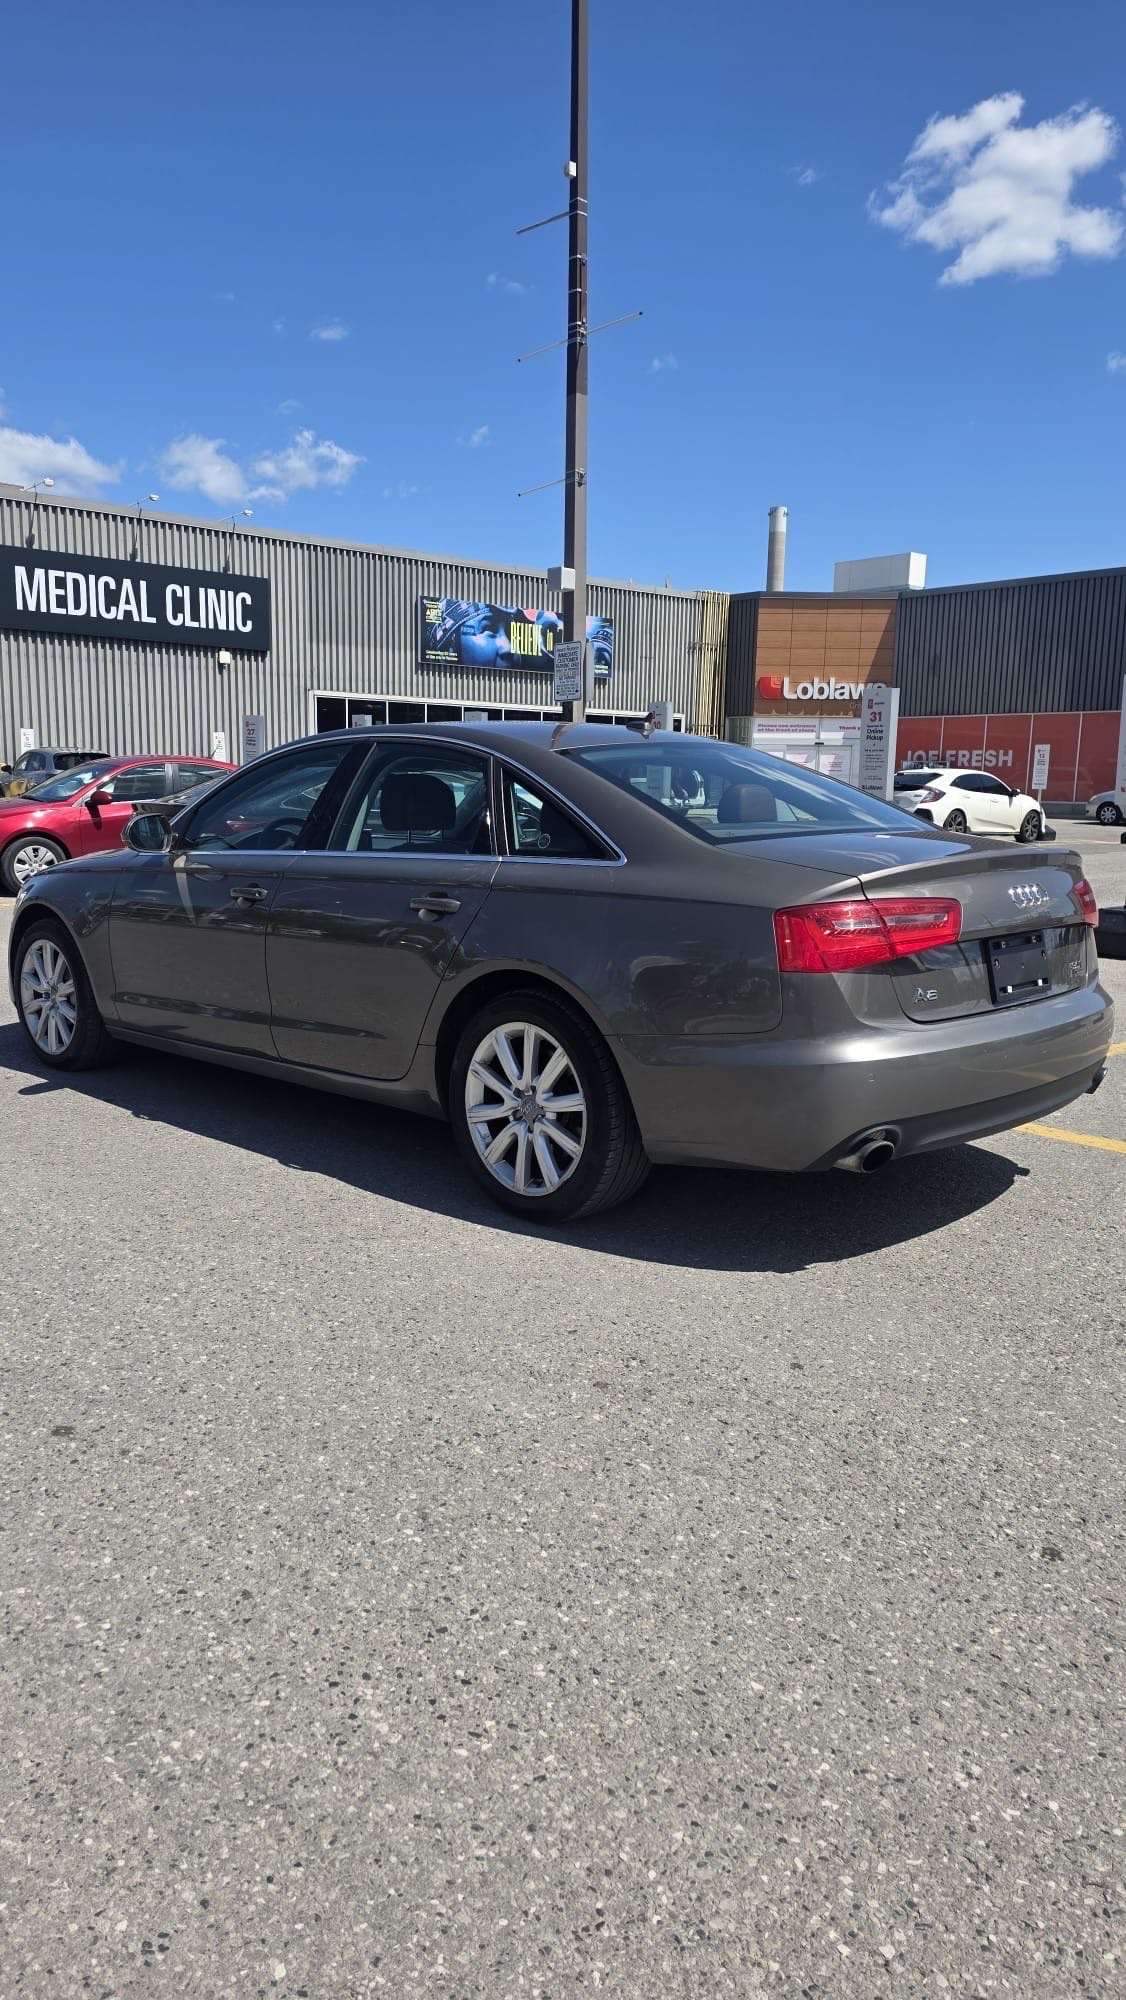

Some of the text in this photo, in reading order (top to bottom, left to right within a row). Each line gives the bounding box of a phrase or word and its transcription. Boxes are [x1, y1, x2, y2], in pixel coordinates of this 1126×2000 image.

[14, 565, 253, 633] MEDICAL CLINIC
[511, 621, 542, 656] BELIEVE
[783, 677, 887, 700] Loblaw
[869, 712, 882, 722] 31
[866, 734, 883, 742] Pickup
[907, 750, 1013, 767] JOE FRESH
